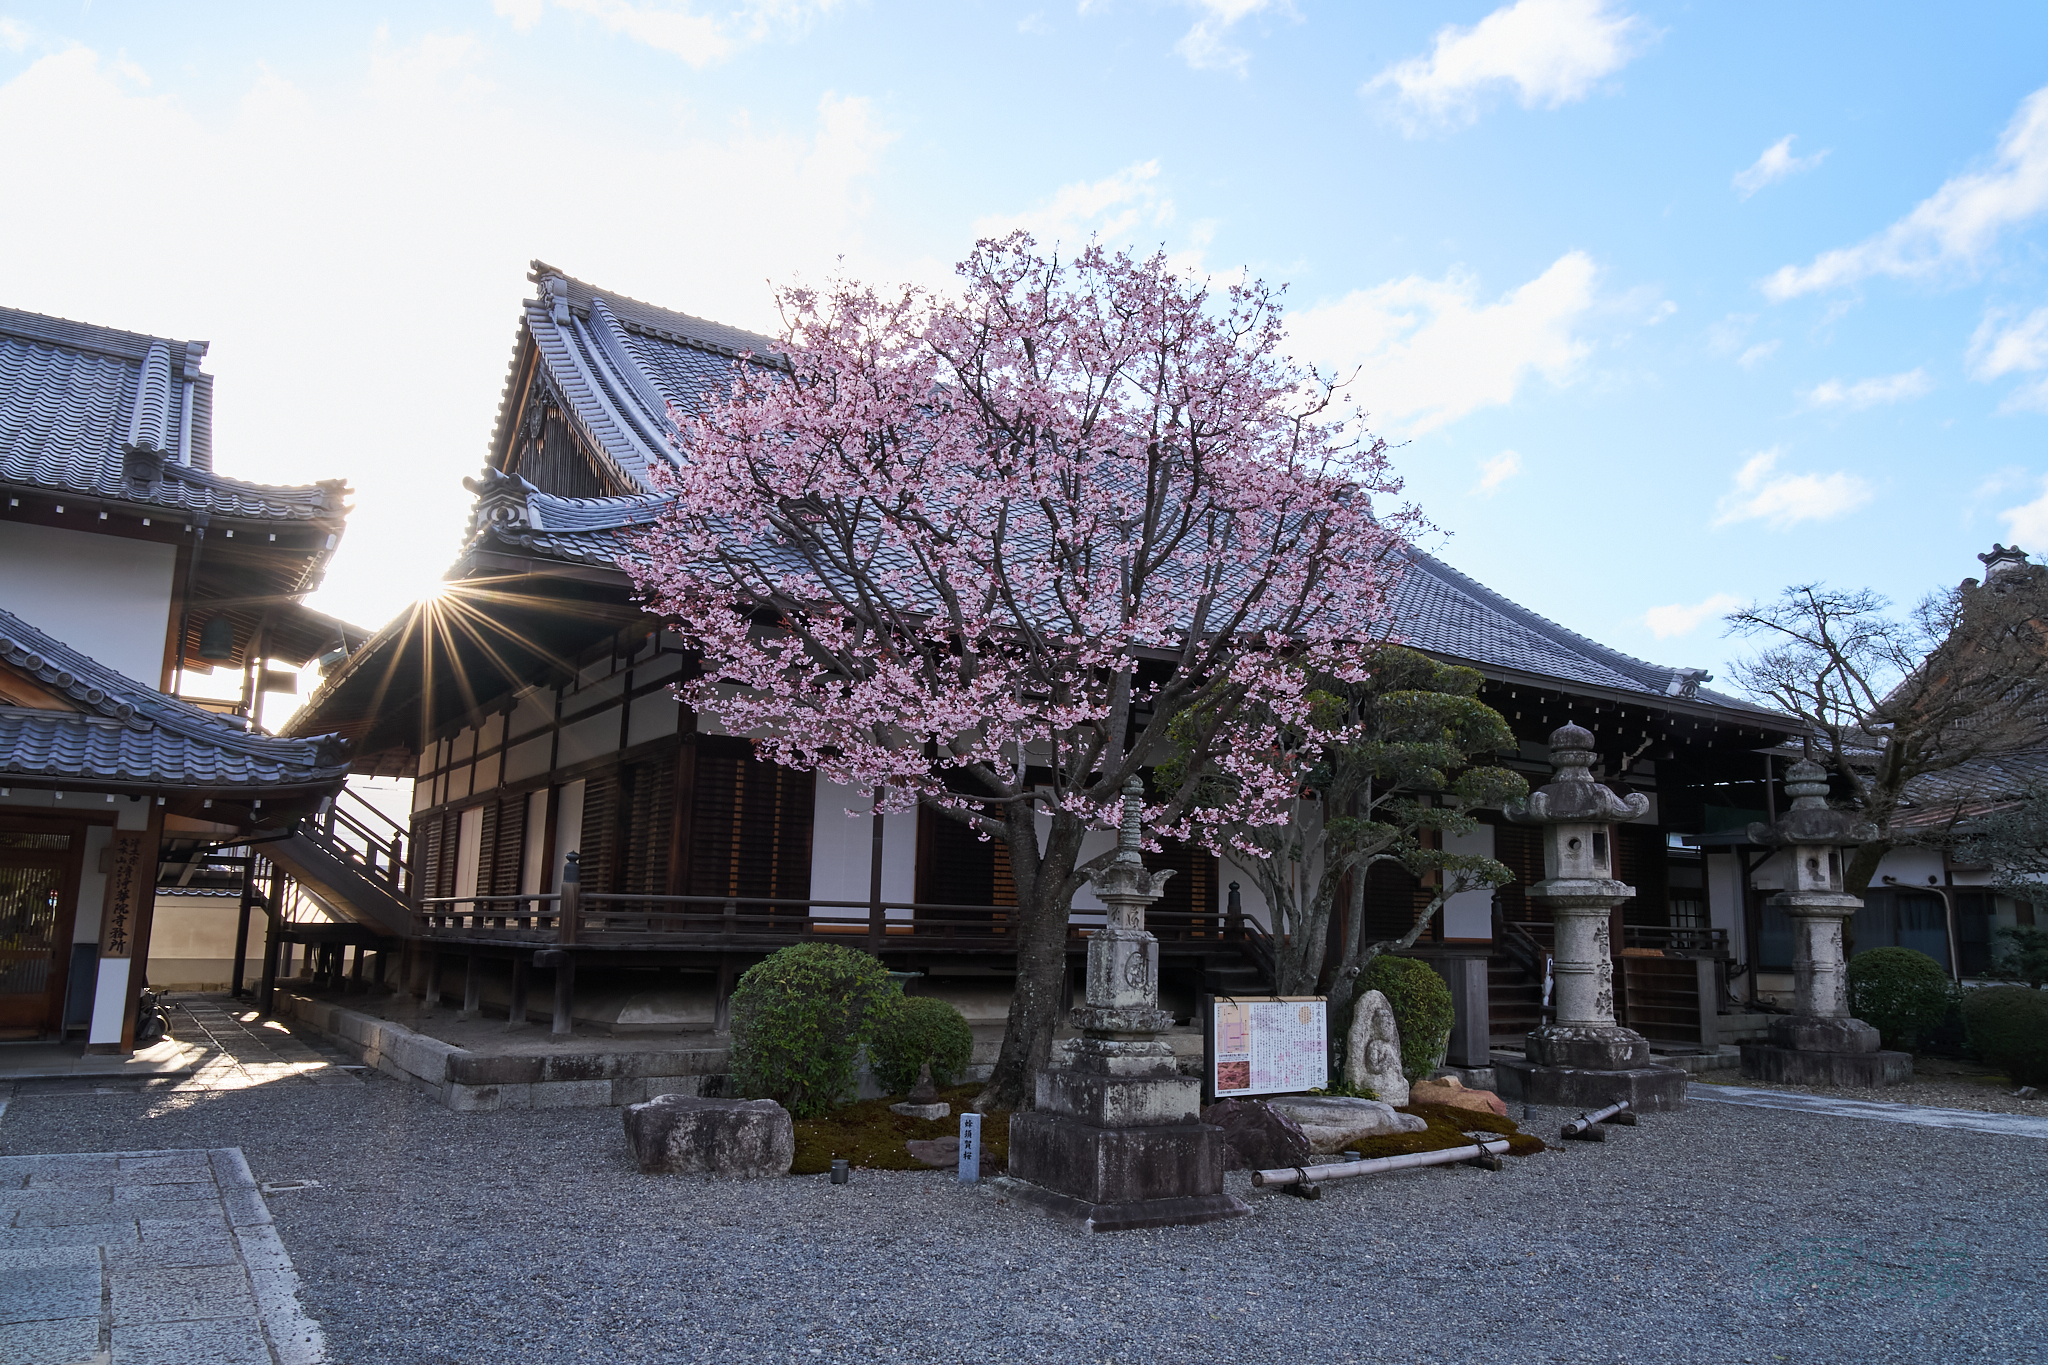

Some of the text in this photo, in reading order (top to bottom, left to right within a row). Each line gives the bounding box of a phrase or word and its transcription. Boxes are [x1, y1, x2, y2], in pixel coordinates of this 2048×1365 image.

[116, 838, 129, 864] 大本山
[963, 1119, 974, 1160] 蜂須賀桜
